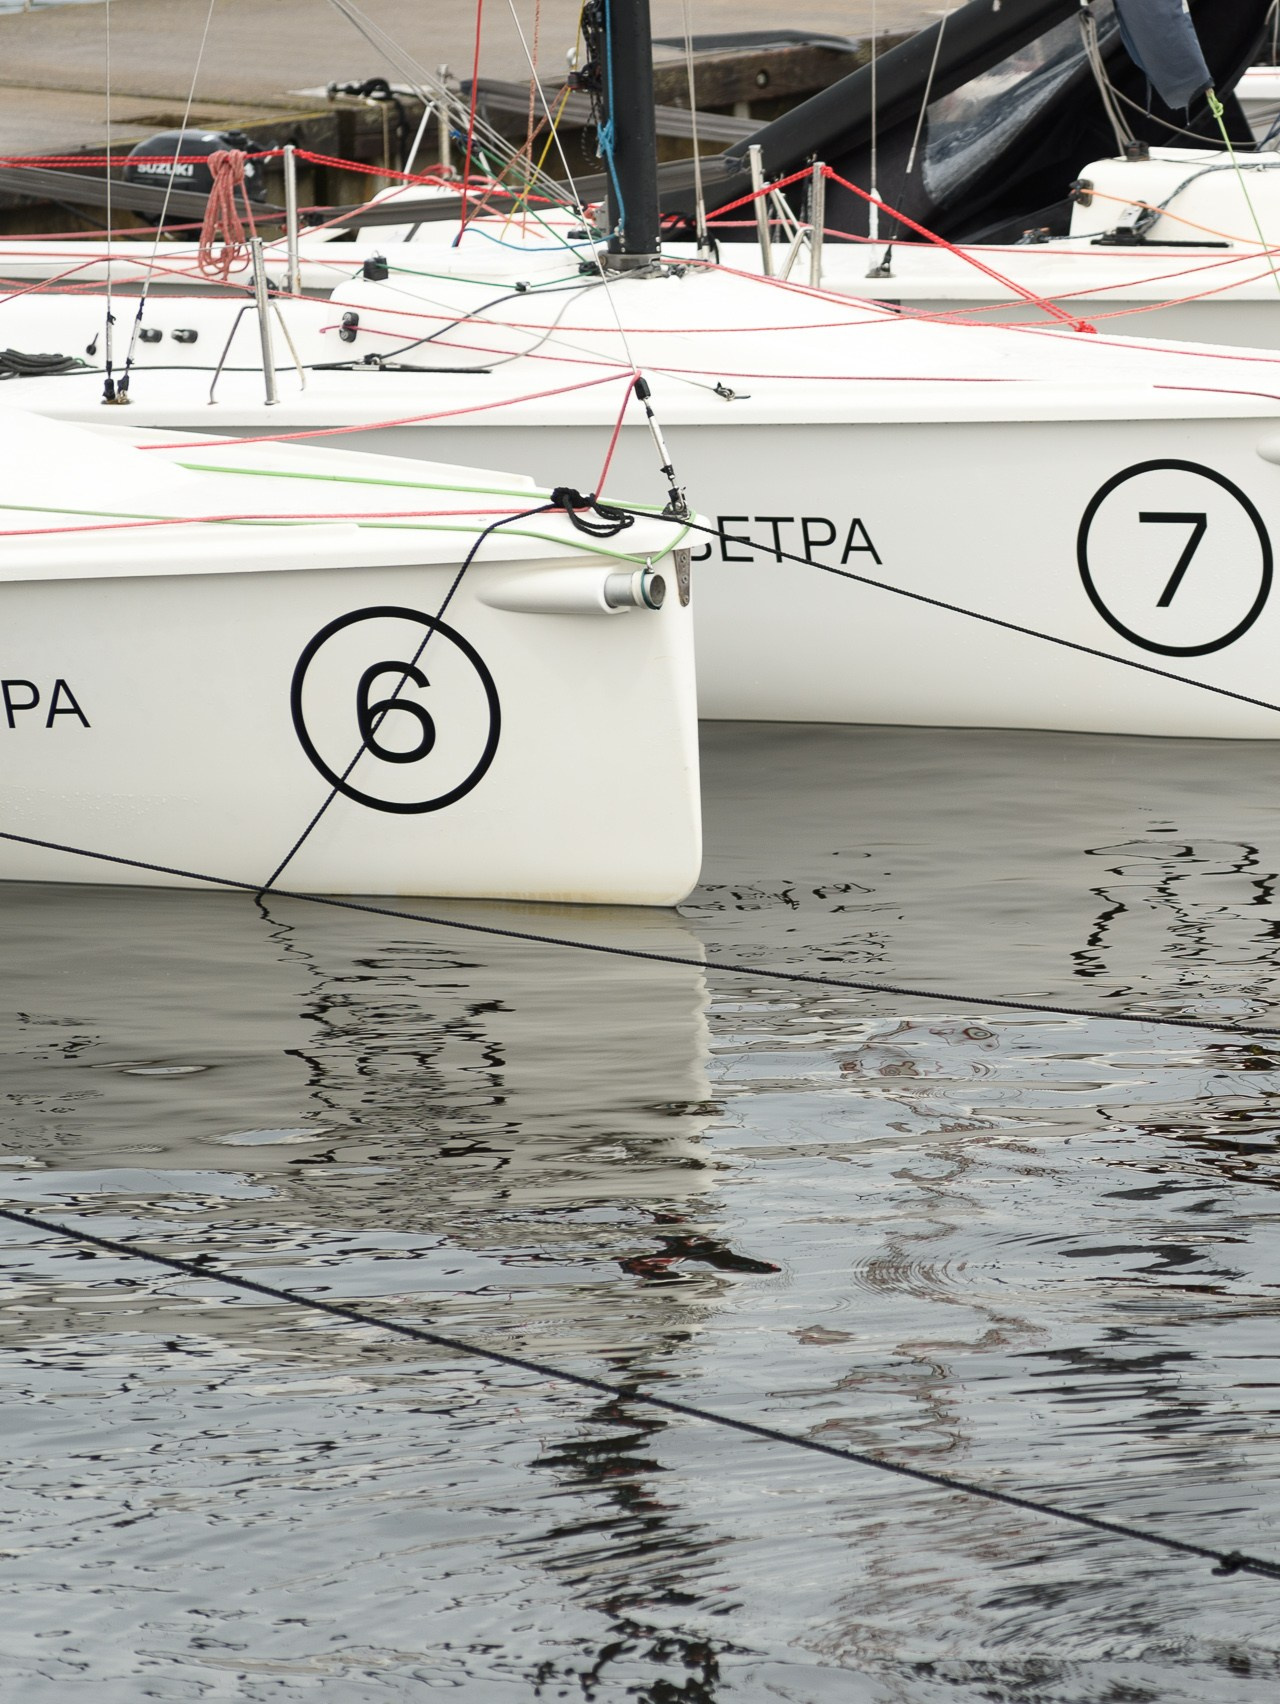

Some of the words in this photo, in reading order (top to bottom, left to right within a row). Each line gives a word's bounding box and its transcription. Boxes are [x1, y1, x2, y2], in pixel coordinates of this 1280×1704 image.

[136, 163, 194, 177] SUZUKI
[1138, 512, 1207, 608] 7
[357, 660, 436, 764] 6
